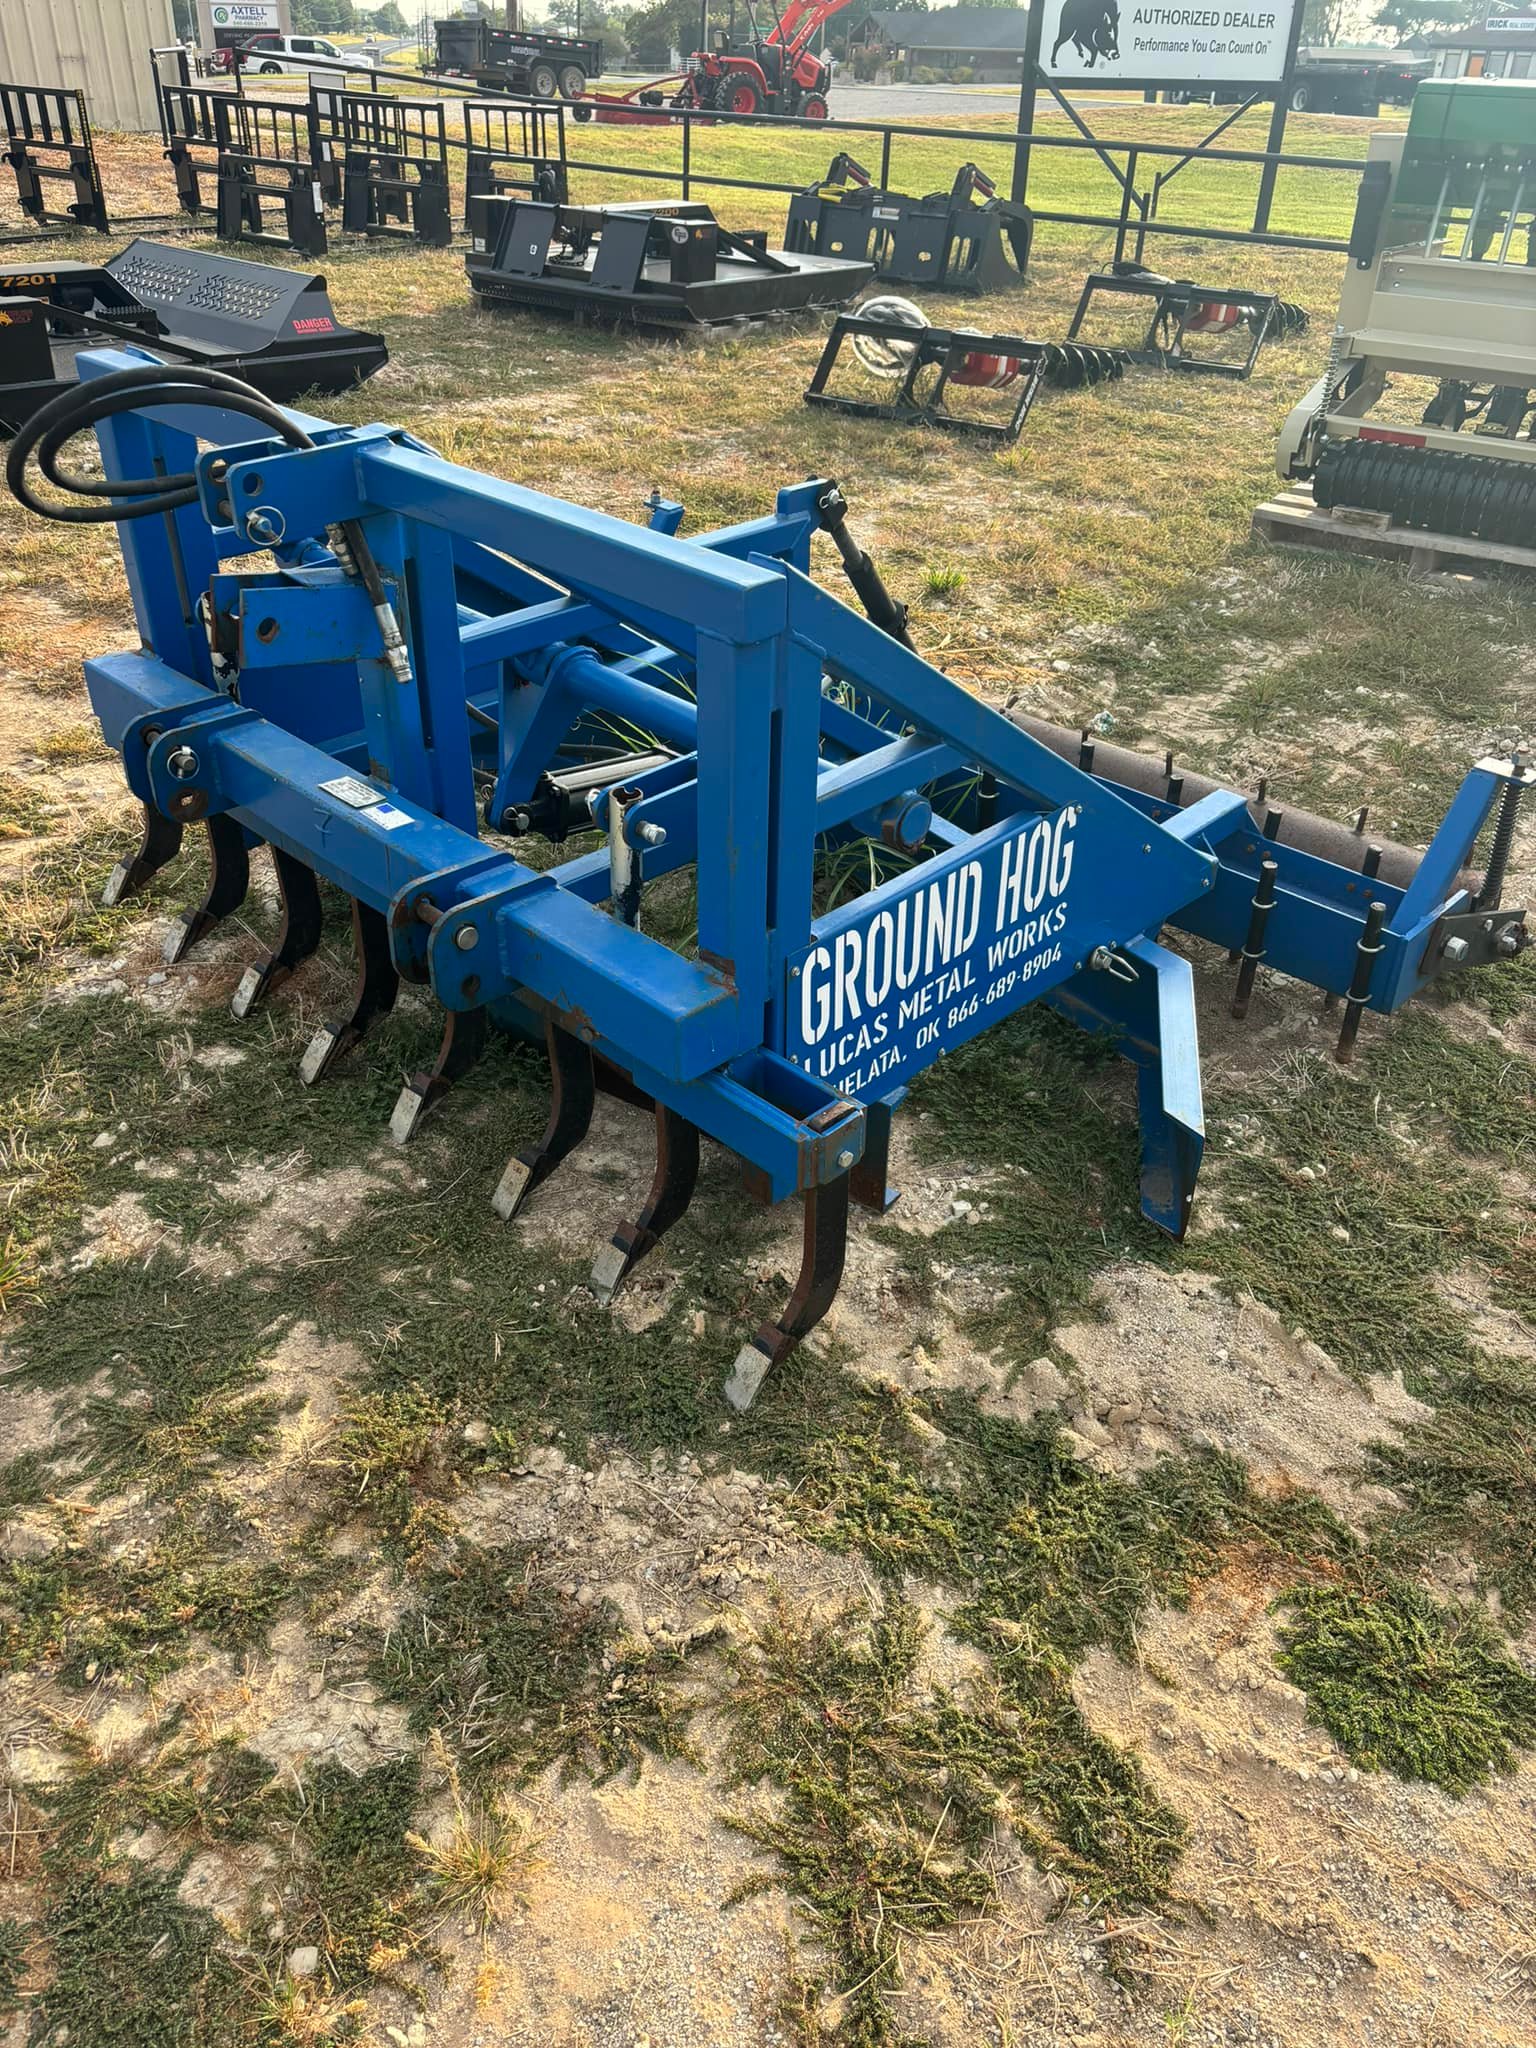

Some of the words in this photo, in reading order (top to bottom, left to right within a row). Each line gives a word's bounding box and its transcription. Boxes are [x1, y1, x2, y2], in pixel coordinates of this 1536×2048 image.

[231, 6, 268, 16] AXTELL
[1133, 8, 1220, 27] AUTHORIZED
[1223, 11, 1276, 29] DEALER
[1133, 37, 1190, 53] Performance
[1191, 39, 1208, 53] You
[1209, 39, 1226, 53] Can
[1228, 40, 1254, 54] Count
[0, 273, 57, 288] 7201
[292, 316, 333, 329] DANGER
[802, 860, 983, 1046] GROUND
[995, 806, 1078, 932] HOG
[898, 959, 976, 1030] METAL
[987, 901, 1068, 972] WORKS
[916, 1017, 941, 1050] OK
[947, 942, 1062, 1030] 866-689-8904
